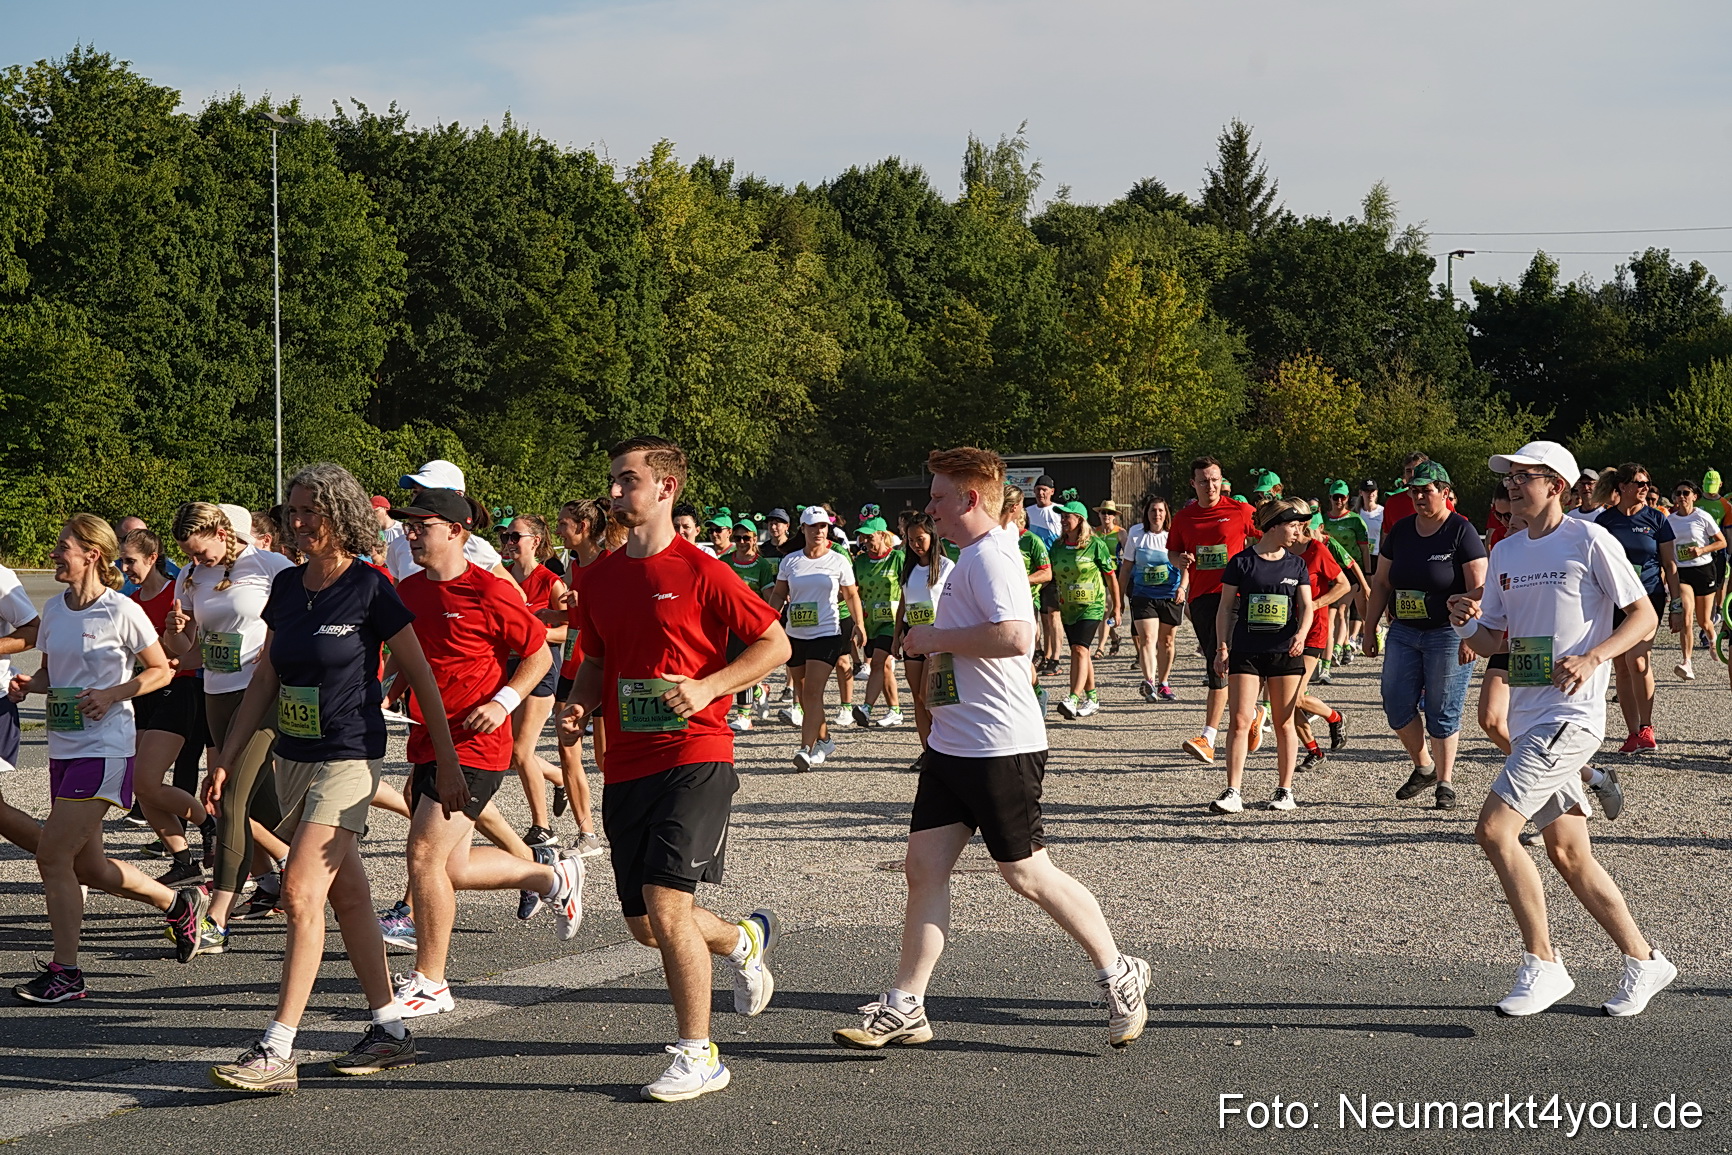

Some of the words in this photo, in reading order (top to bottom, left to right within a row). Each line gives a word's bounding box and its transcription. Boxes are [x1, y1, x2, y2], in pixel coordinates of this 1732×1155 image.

[1201, 553, 1222, 562] 1721
[1148, 572, 1164, 580] 1215
[1513, 572, 1567, 583] SCHWARZ
[1076, 590, 1086, 598] 98
[1258, 604, 1278, 614] 885
[1400, 600, 1416, 610] 893
[794, 610, 812, 620] 1877
[910, 610, 930, 620] 1876
[210, 646, 230, 660] 103
[1512, 654, 1542, 670] 1361
[946, 673, 956, 697] 2022
[48, 702, 68, 718] 102
[280, 701, 309, 722] 1413
